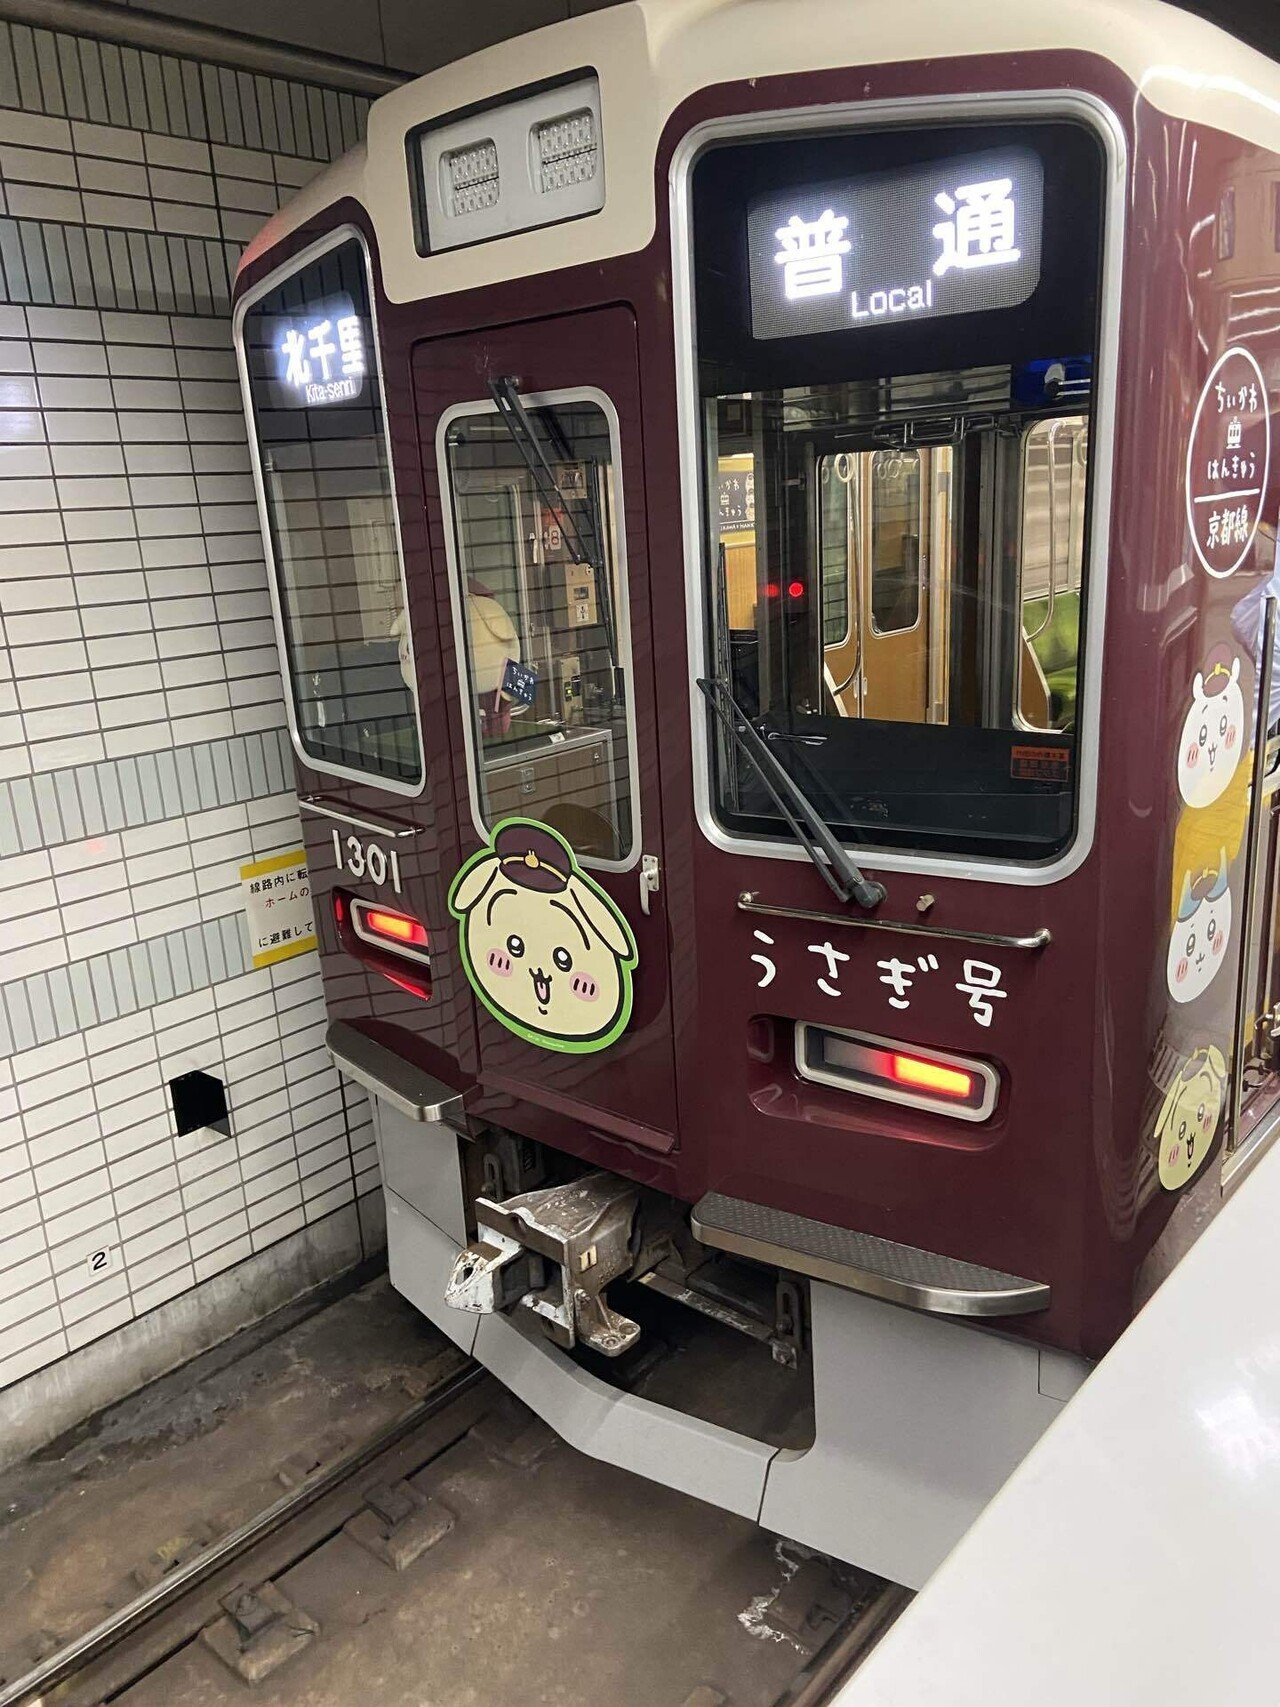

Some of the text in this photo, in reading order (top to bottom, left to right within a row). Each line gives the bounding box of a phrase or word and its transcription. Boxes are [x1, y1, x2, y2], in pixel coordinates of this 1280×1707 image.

[774, 178, 1021, 300] 普通
[851, 278, 932, 319] Local
[281, 315, 365, 388] 北千里
[305, 376, 356, 404] Kita-senri
[1215, 381, 1258, 413] ちいかわ
[1207, 452, 1256, 480] はんきゅう
[1206, 504, 1249, 549] 京都線
[332, 829, 401, 894] 1301
[265, 886, 310, 909] ホームの
[258, 921, 314, 948] に避難して
[750, 929, 1008, 1027] うさぎ号
[92, 1251, 107, 1271] 2
